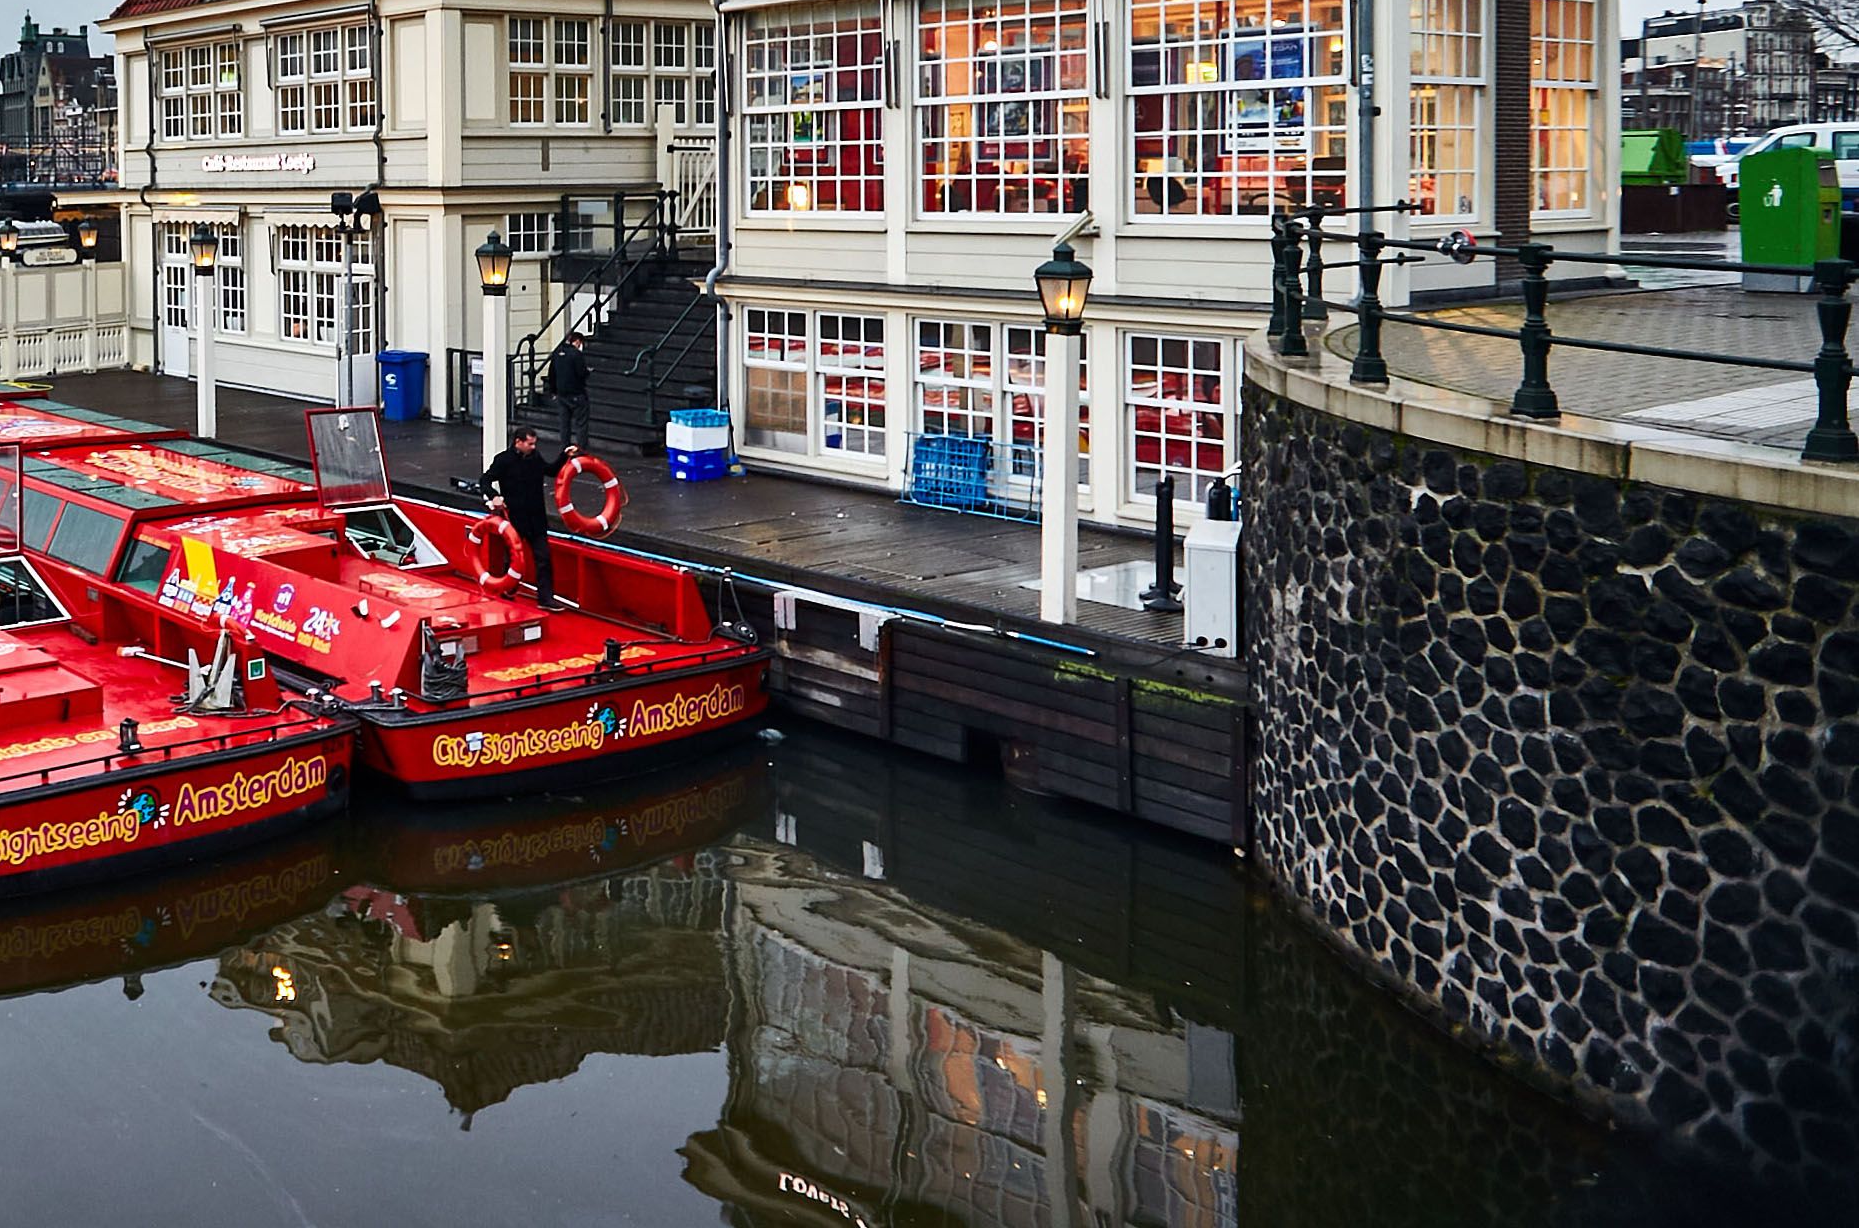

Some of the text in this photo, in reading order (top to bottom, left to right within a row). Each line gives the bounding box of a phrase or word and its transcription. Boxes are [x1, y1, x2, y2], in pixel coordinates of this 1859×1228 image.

[109, 715, 199, 735] oard
[629, 683, 744, 738] Amsterdam
[173, 755, 328, 827] Amsterdam
